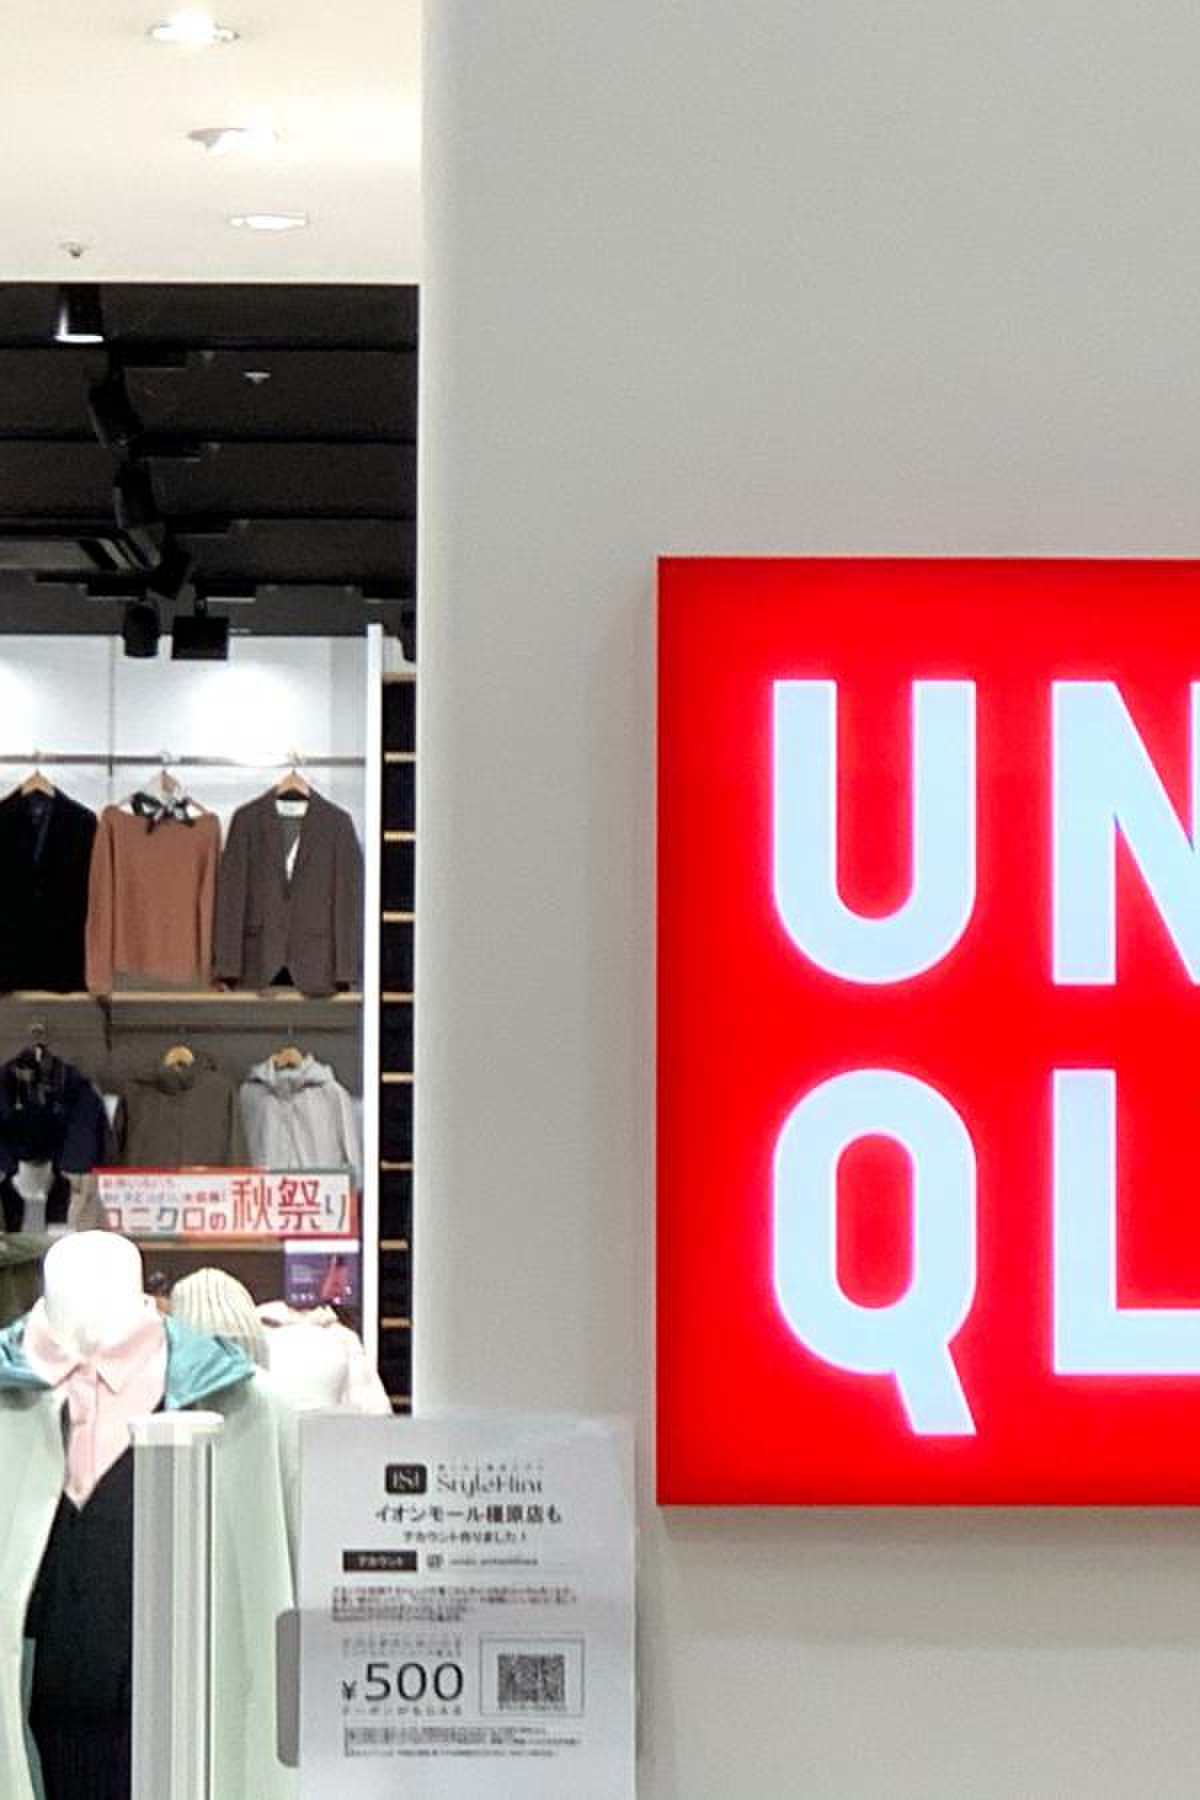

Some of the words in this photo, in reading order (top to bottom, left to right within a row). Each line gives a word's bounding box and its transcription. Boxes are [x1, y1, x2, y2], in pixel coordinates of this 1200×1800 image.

[107, 1176, 347, 1231] ユニクロの秋祭り
